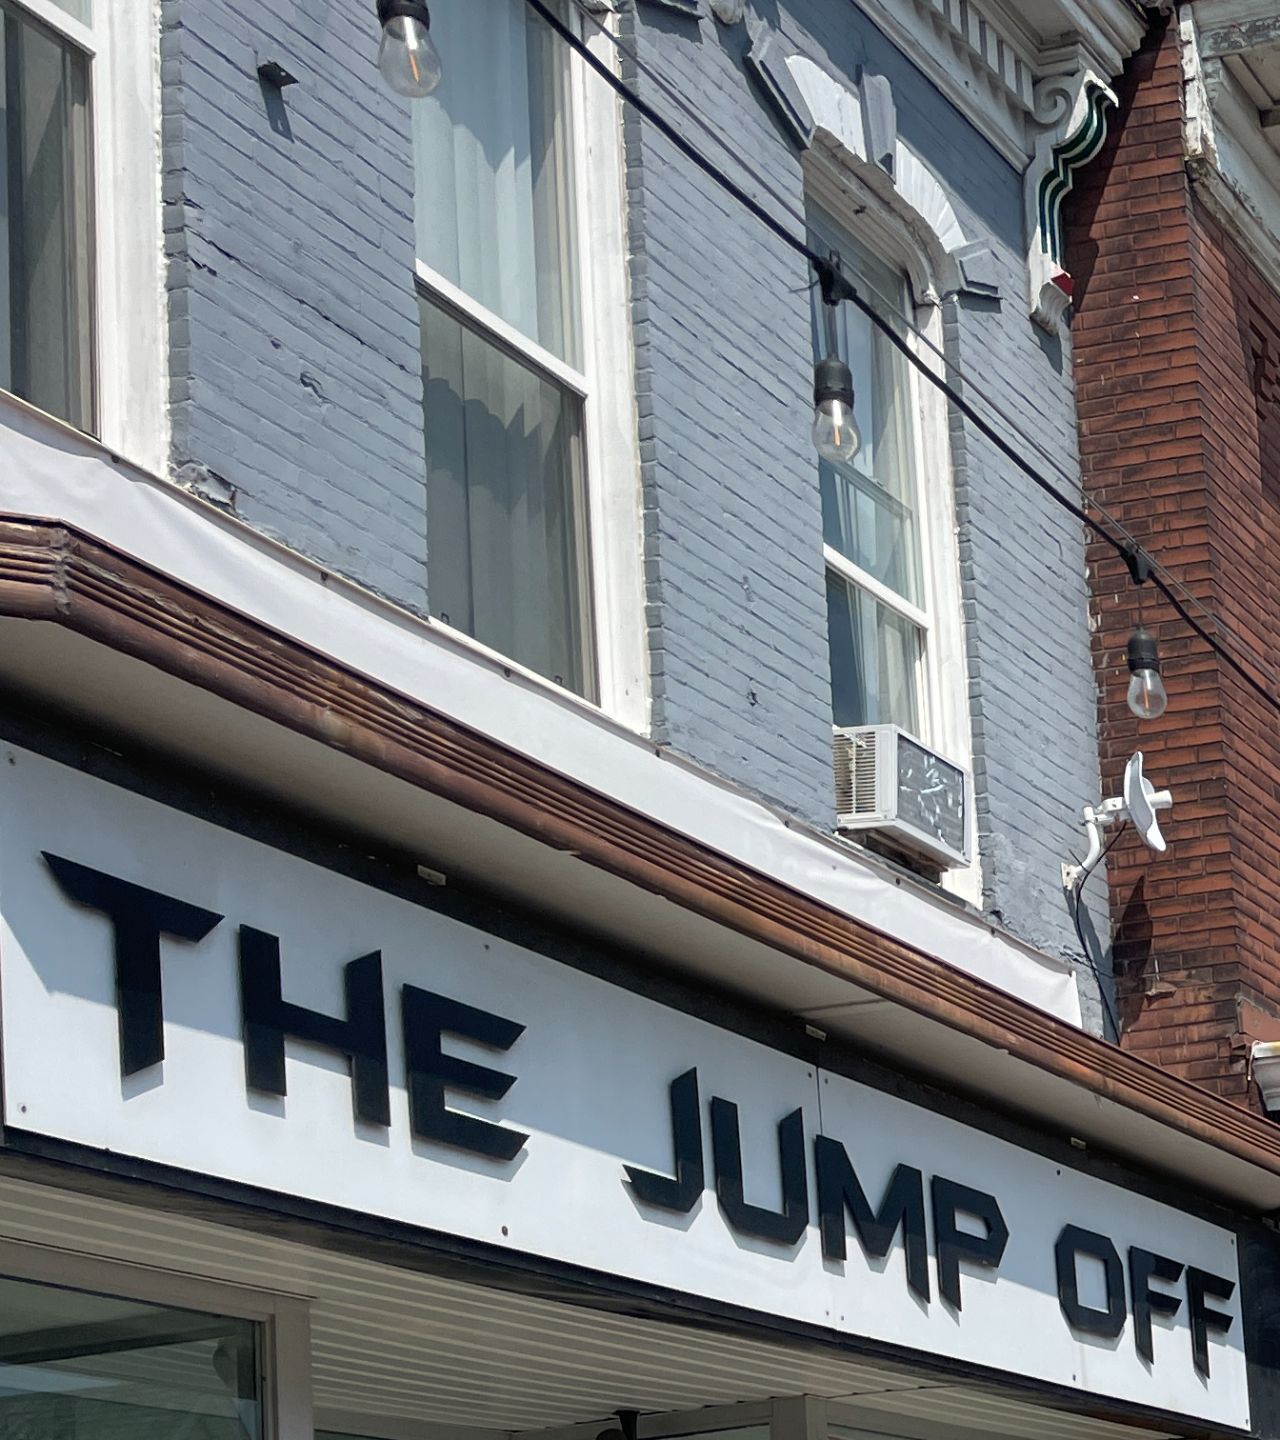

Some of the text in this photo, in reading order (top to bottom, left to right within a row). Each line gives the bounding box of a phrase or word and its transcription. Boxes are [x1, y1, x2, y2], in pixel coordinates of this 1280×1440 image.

[40, 849, 1236, 1379] THE JUMP OFF
